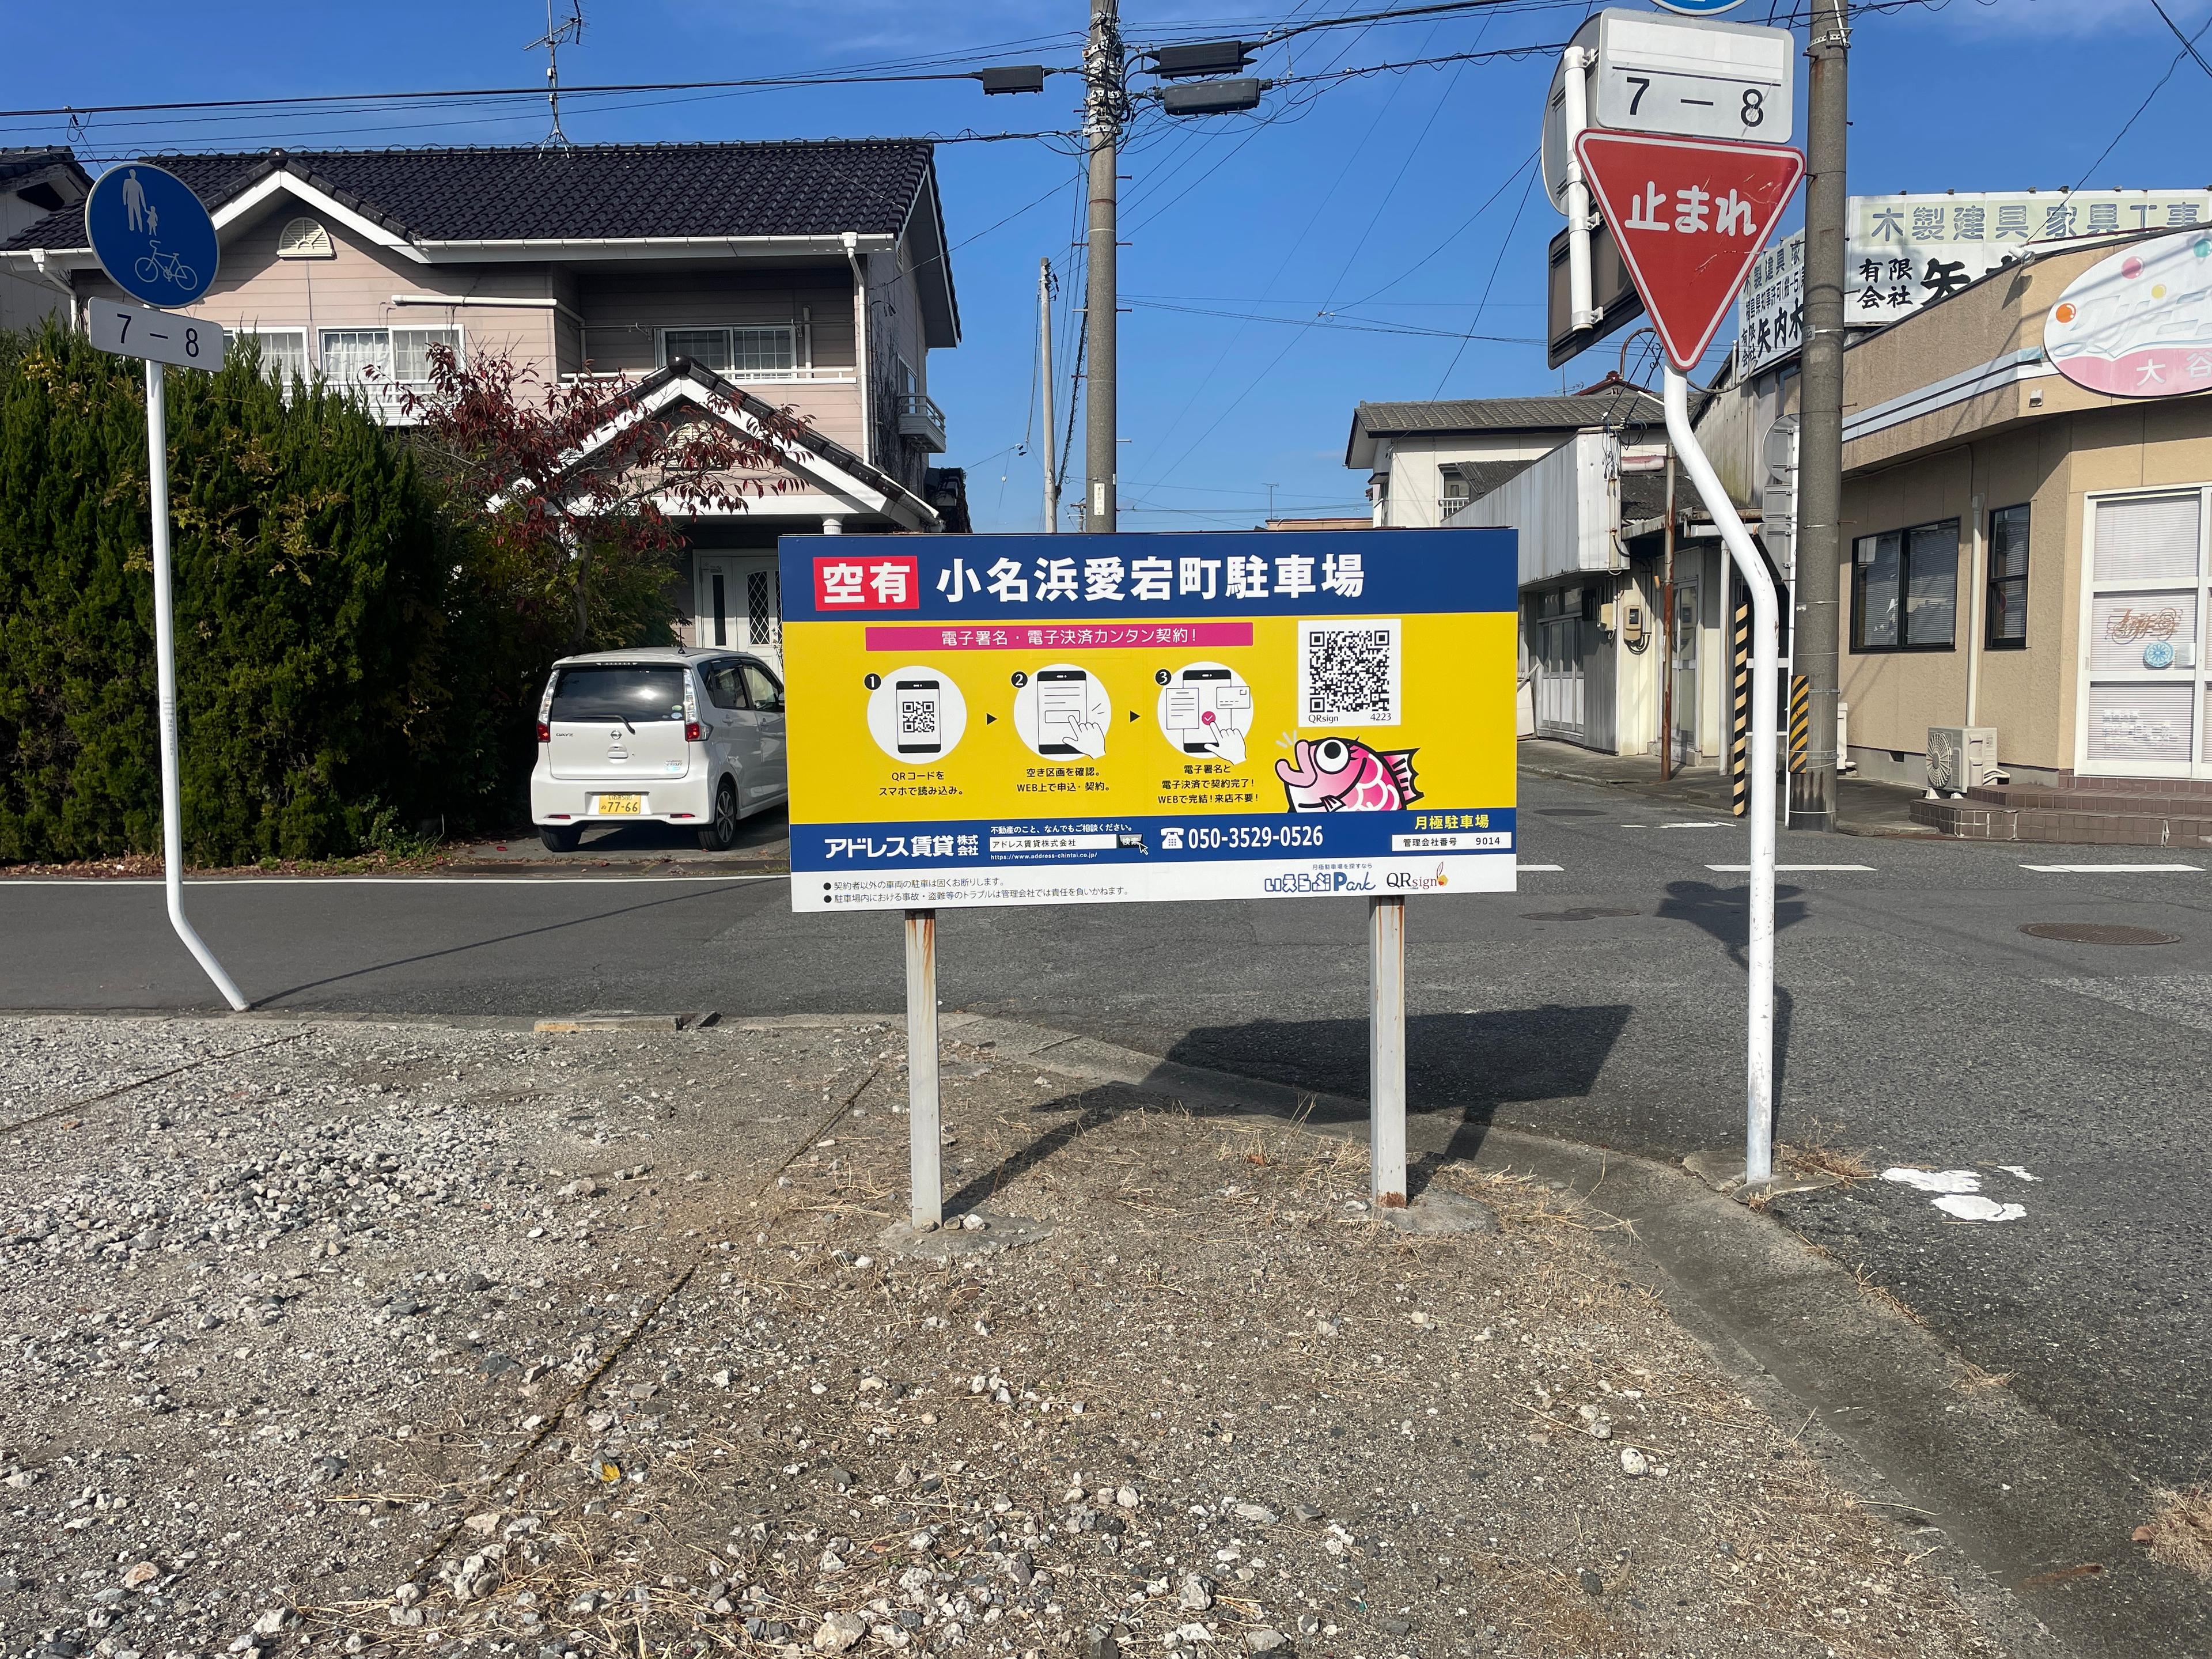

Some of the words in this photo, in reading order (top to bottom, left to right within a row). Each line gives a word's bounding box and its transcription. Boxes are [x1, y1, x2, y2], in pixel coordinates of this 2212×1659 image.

[1624, 181, 1757, 237] 止まれ
[1859, 258, 1912, 283] 有限
[1857, 285, 1913, 309] 会社
[823, 562, 911, 604] 空有
[936, 554, 1365, 603] 小名浜愛宕町駐車場
[1308, 714, 1339, 724] QRsign
[1370, 713, 1392, 721] 4223
[1027, 767, 1100, 778] 空き区画を確認。
[1184, 764, 1231, 774] 電子署名と
[892, 771, 944, 782] QRコードを
[879, 785, 964, 796] スマホで読み込み。
[608, 801, 638, 813] 77-66
[1415, 814, 1490, 830] 月極駐車場
[990, 823, 1132, 835] 不動産のこと、なんでもご相談ください。
[957, 834, 979, 845] 株式
[1188, 825, 1323, 849] 050-3529-0526
[1403, 838, 1457, 847] 管理会社番号
[1476, 837, 1501, 846] 9014
[824, 835, 954, 859] アドレス賃貸
[992, 839, 1076, 849] アドレス賃貸株式会社
[957, 846, 979, 856] 会社
[990, 852, 1098, 861] https://www.address-chintai.co.jp/
[834, 877, 1004, 891] 契約者以外の車両の駐車は固くお断りします。
[1387, 872, 1437, 890] QRsign
